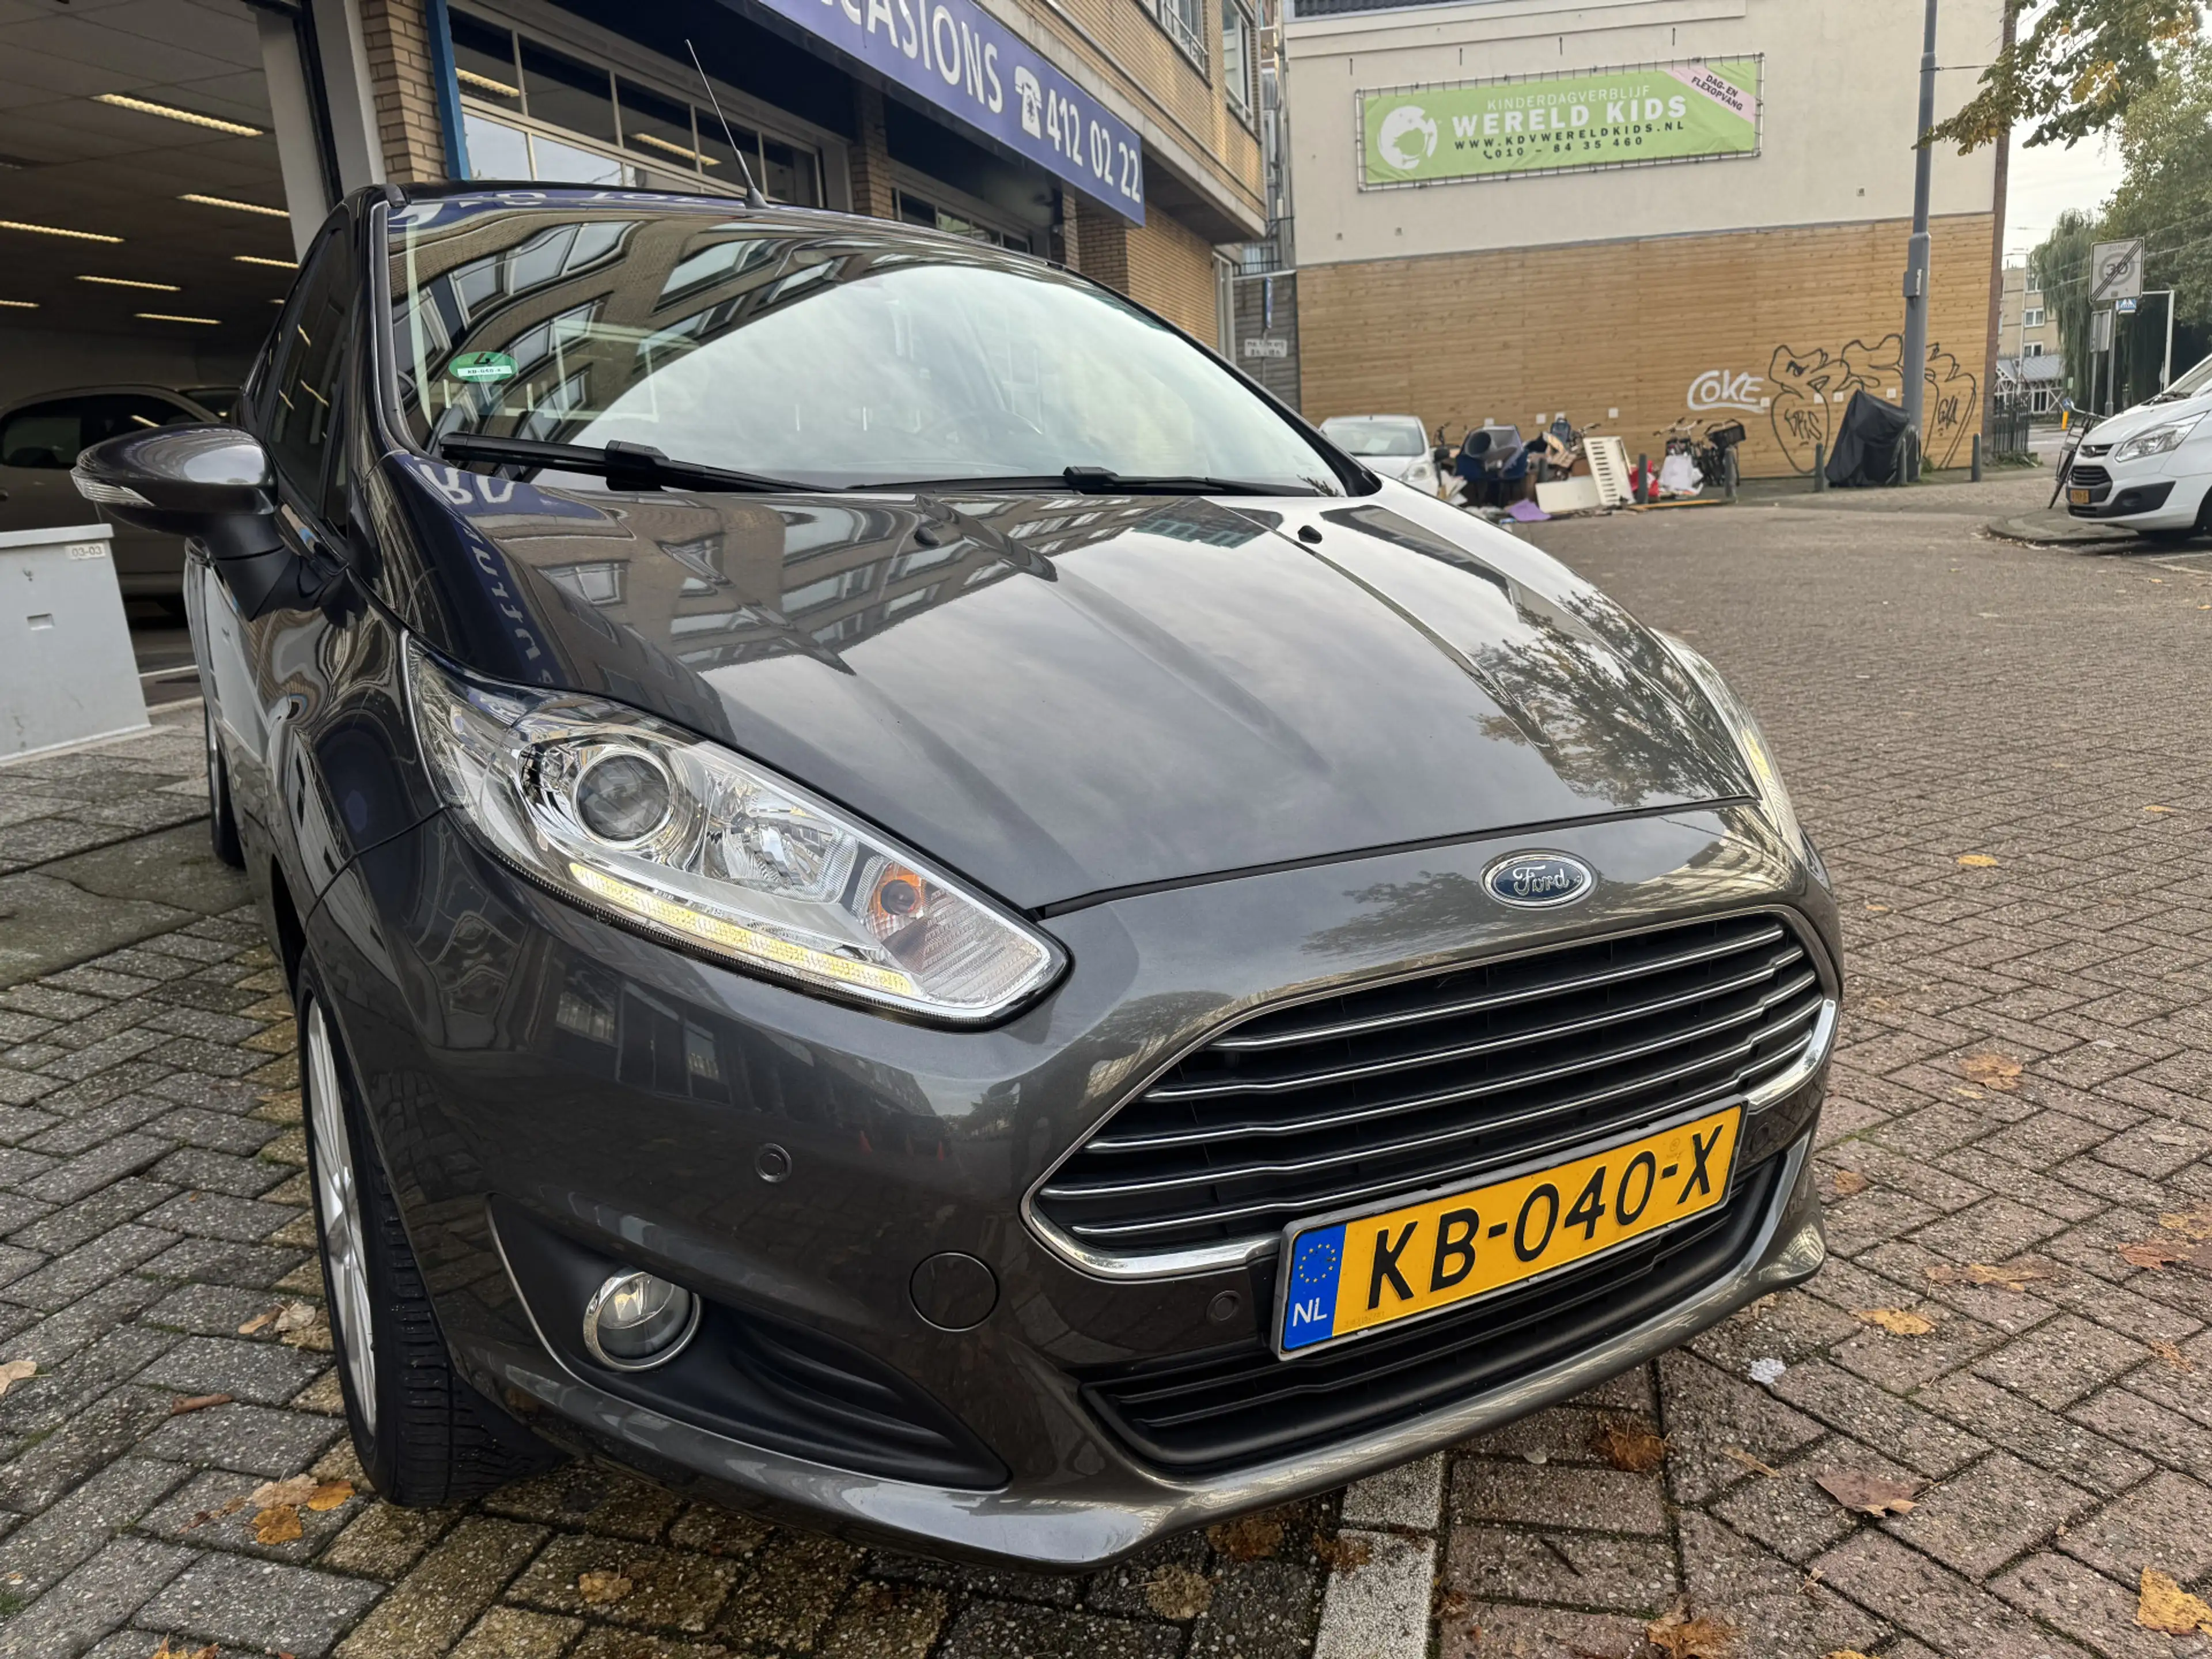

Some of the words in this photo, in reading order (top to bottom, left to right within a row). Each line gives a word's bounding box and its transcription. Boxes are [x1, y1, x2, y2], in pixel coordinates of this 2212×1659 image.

[1487, 85, 1650, 111] KINDERDAGVERBLIJF
[1691, 75, 1743, 111] FLEXOPVANG
[1706, 74, 1725, 90] DAG-
[1726, 86, 1738, 98] EN
[821, 0, 1003, 114] ASIONS
[1047, 88, 1083, 167] 412
[1090, 119, 1113, 187] 02
[1119, 142, 1141, 204] 22
[1452, 104, 1590, 138] WERELD
[1606, 94, 1687, 124] KIDS
[1455, 120, 1684, 150] WWW.KDVWERELDKIDS.NL
[1495, 147, 1524, 158] 010
[1553, 142, 1572, 153] 84
[1584, 139, 1601, 150] 35
[1613, 137, 1642, 147] 460
[2108, 243, 2128, 251] ZONE
[2105, 262, 2129, 277] 30
[71, 546, 103, 557] 03-03
[1512, 865, 1569, 896] Ford
[1366, 1124, 1724, 1311] KB-040-X
[1293, 1296, 1327, 1327] NL
